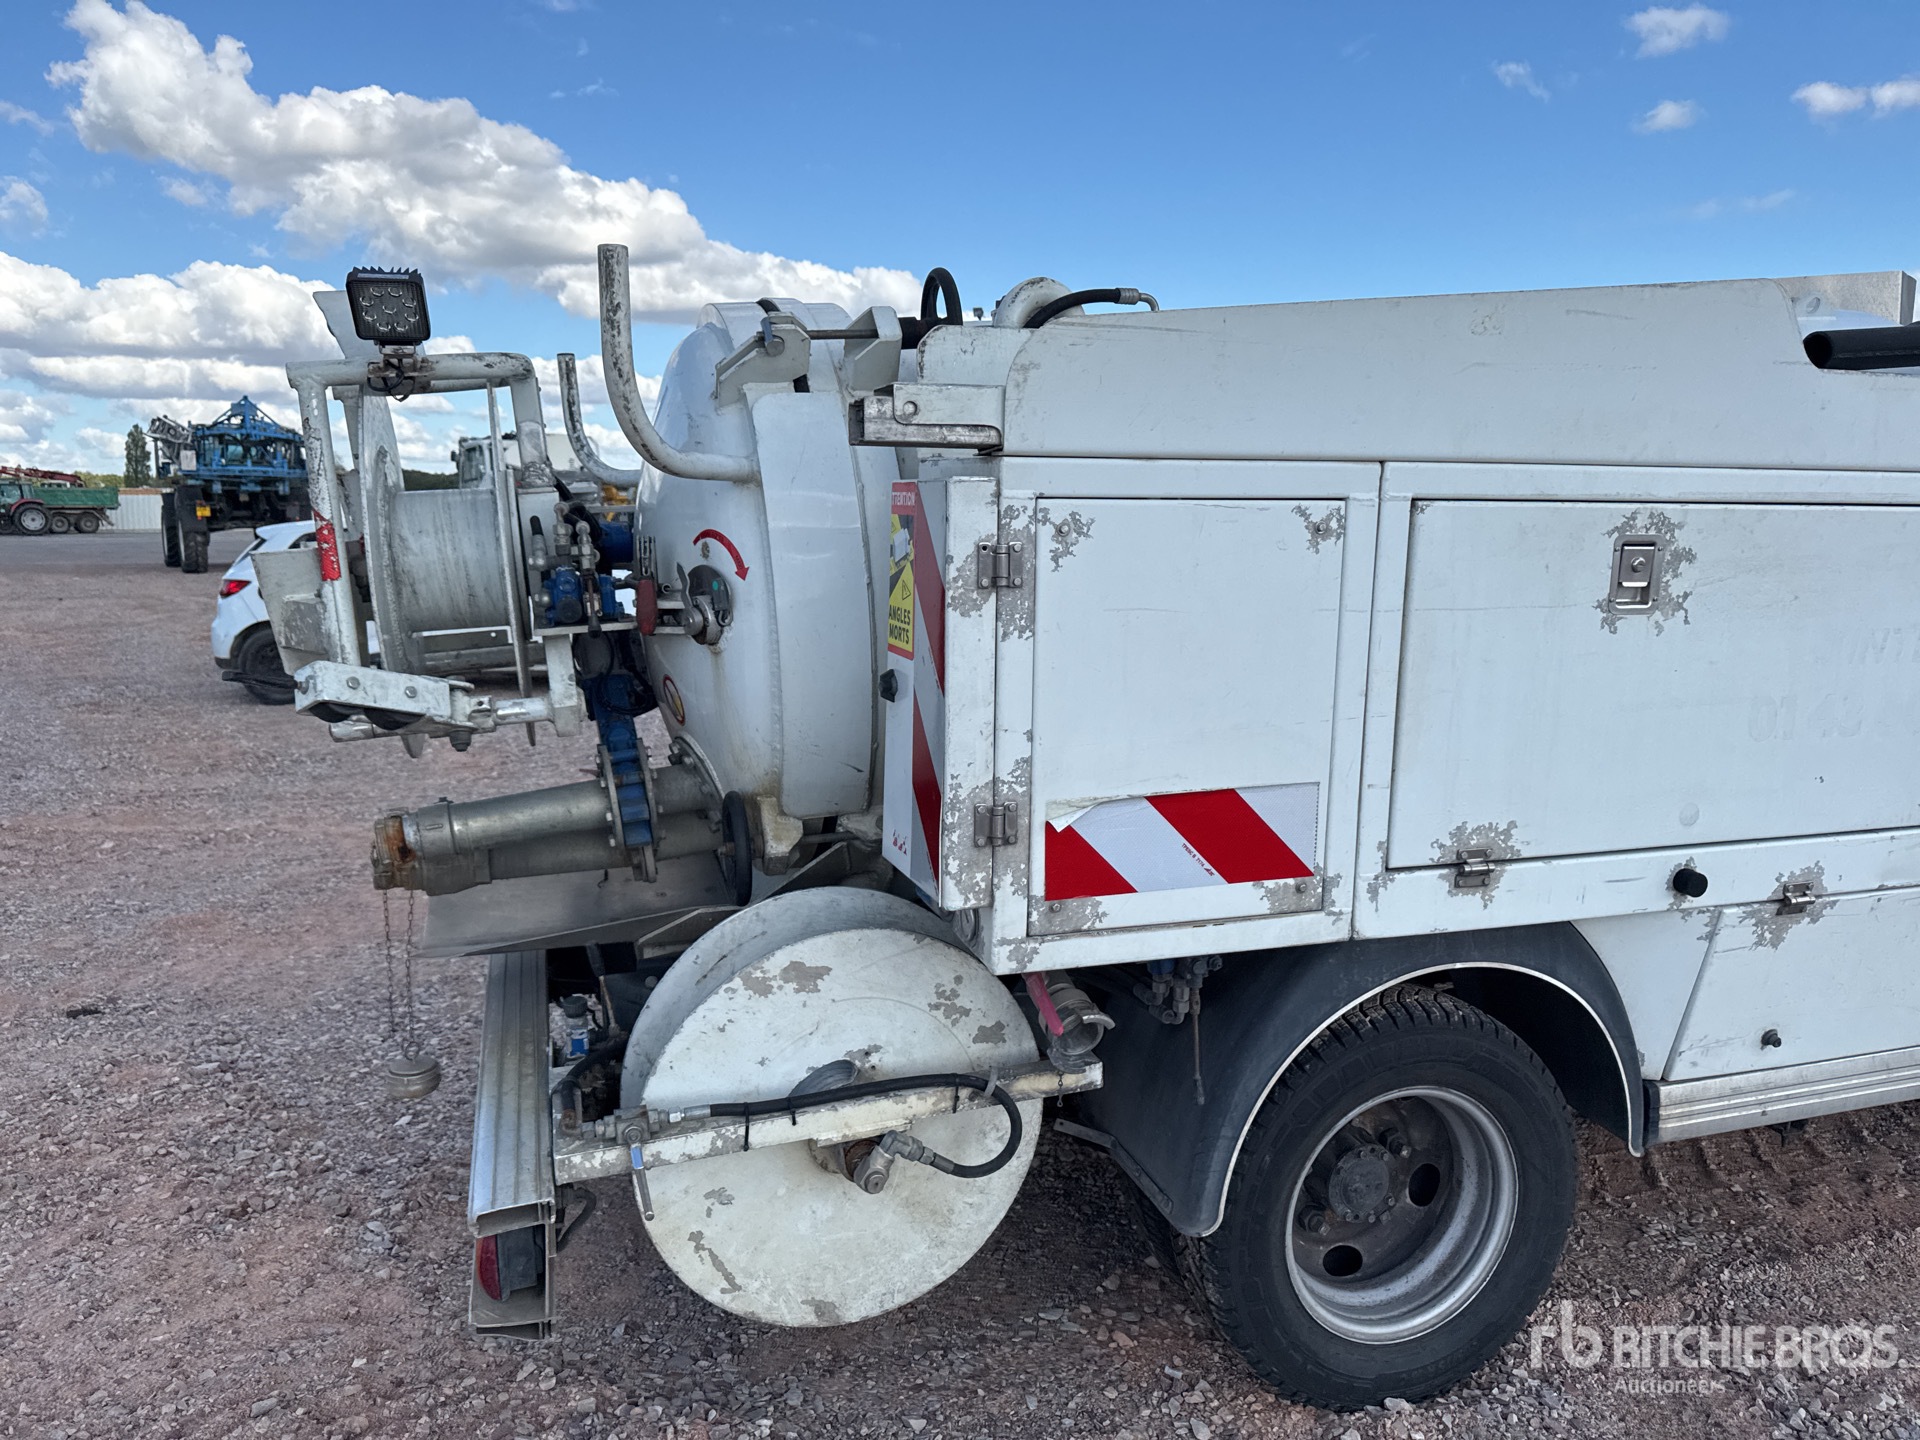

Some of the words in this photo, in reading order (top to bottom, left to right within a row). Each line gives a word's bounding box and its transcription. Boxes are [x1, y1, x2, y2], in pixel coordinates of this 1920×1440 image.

[891, 491, 916, 506] TTENTION
[888, 604, 911, 626] ANGLES
[888, 622, 910, 645] MORTS
